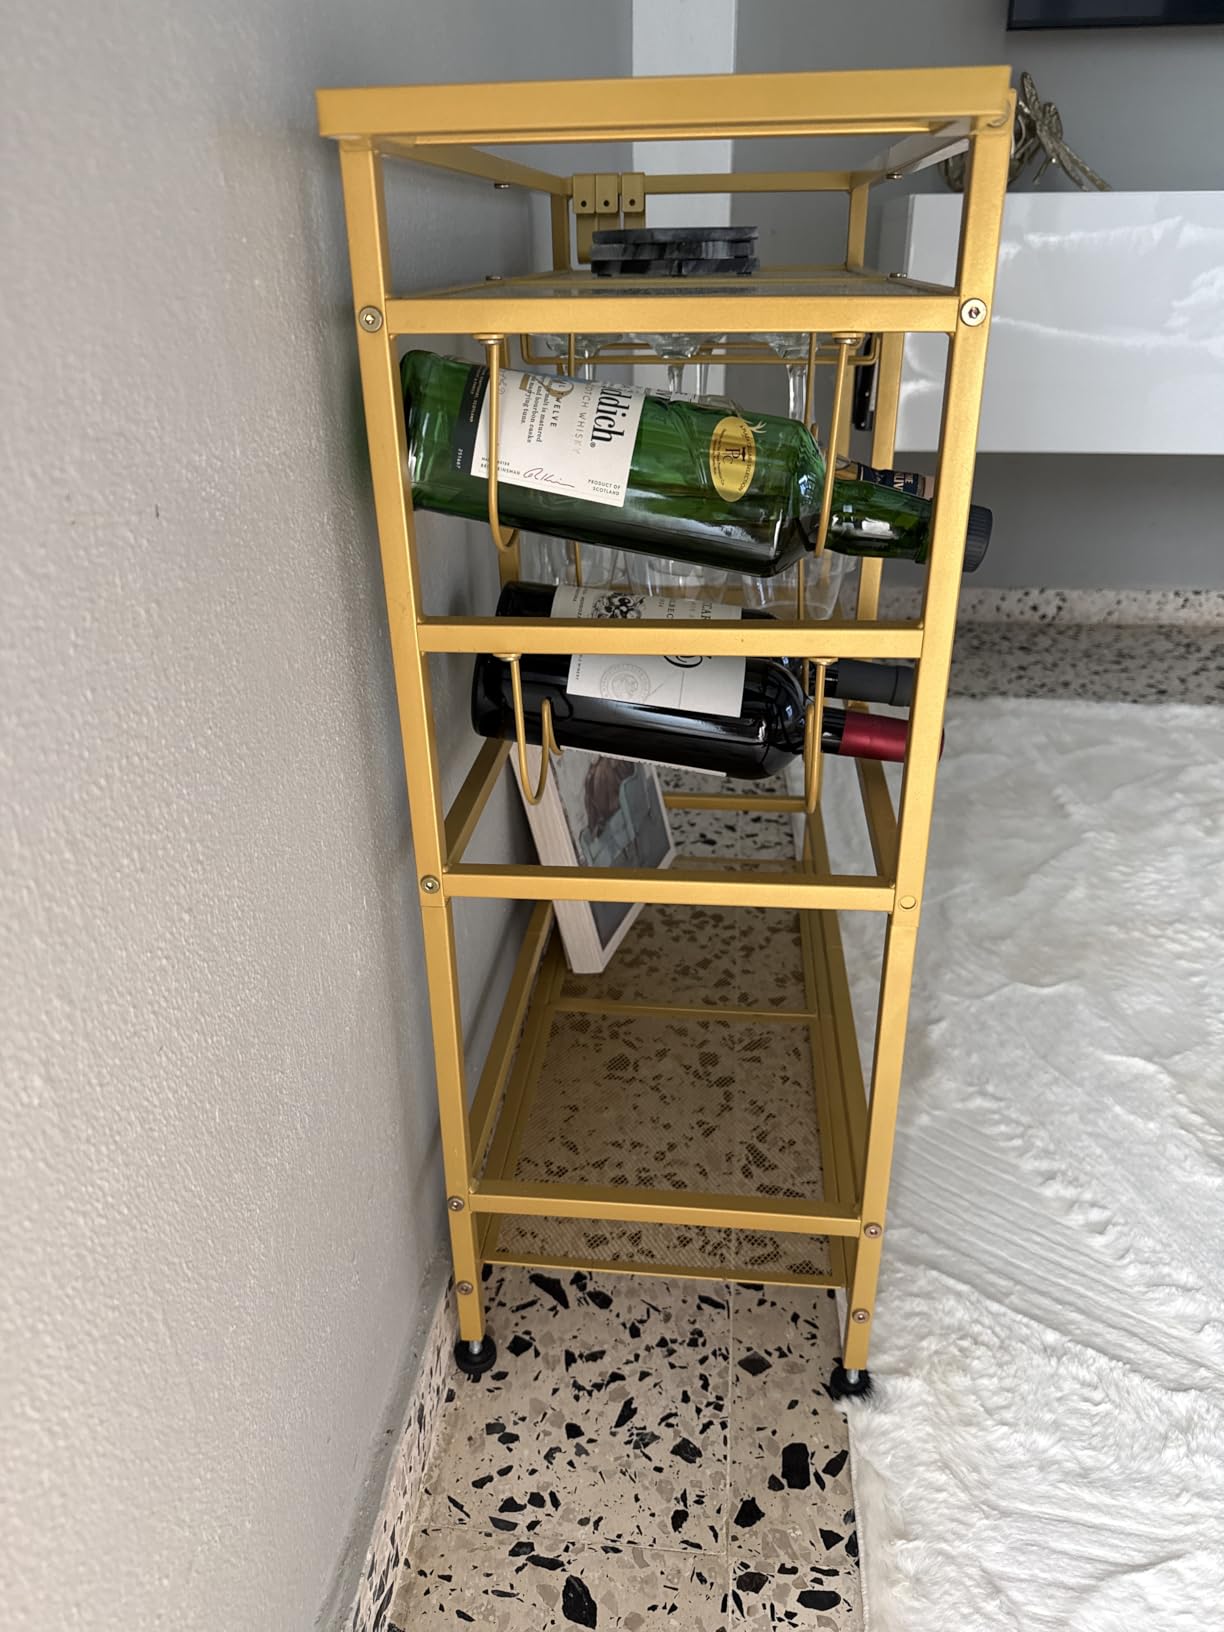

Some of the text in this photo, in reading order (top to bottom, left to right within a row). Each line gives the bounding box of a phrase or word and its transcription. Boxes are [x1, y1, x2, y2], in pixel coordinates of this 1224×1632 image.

[529, 396, 541, 423] bourbon
[535, 413, 546, 443] matured
[572, 412, 587, 455] WHISKY
[587, 479, 613, 488] PRODUCT
[592, 487, 620, 496] SCOTLAND
